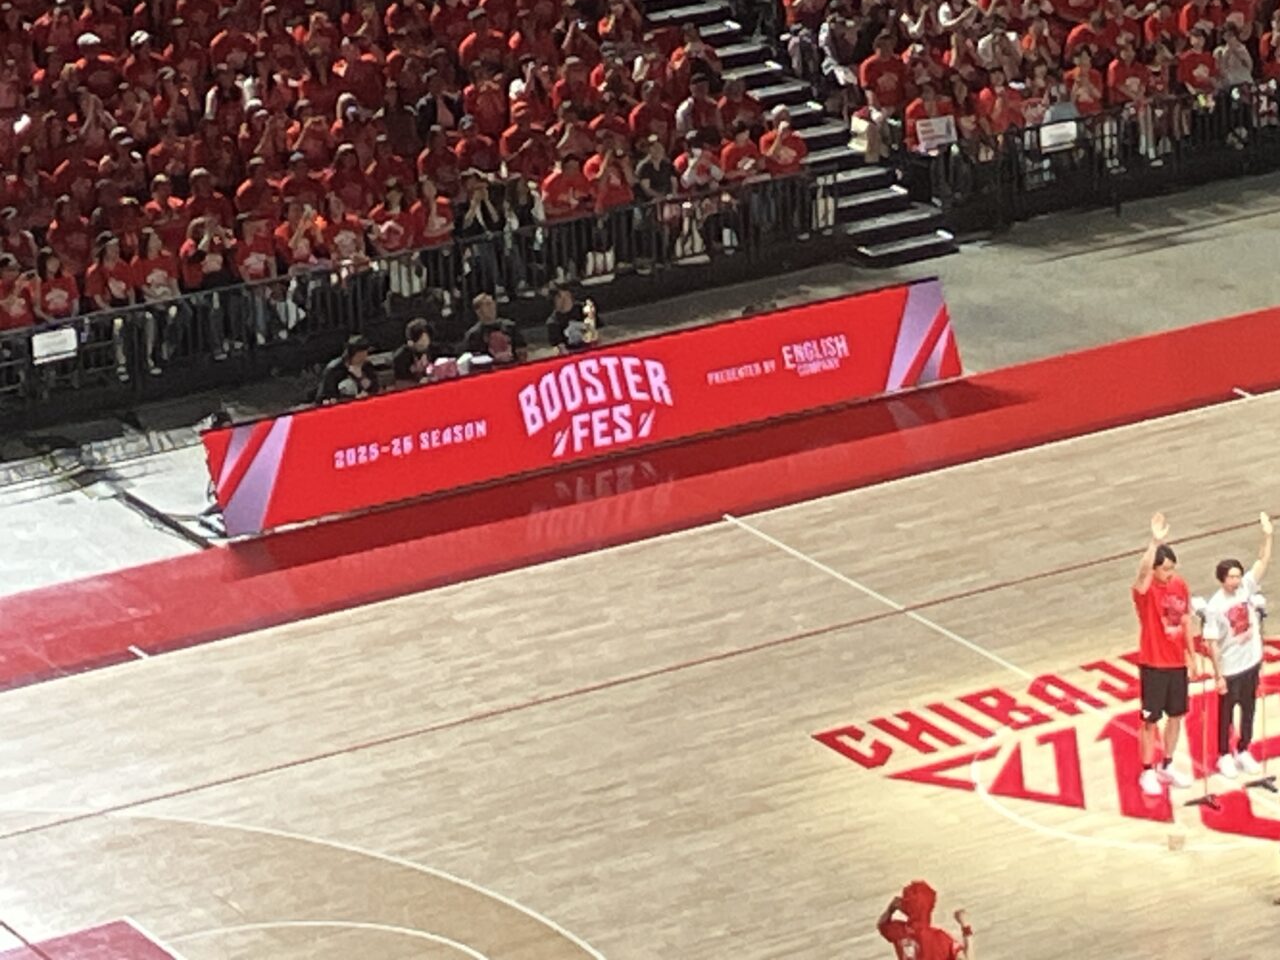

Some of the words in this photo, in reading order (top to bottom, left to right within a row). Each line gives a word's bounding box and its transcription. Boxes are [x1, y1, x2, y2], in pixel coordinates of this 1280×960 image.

[782, 334, 850, 370] ENGLISH
[518, 356, 674, 437] BOOSTER
[334, 435, 413, 469] 2025-26
[419, 419, 487, 450] SEASON
[572, 403, 633, 453] FES
